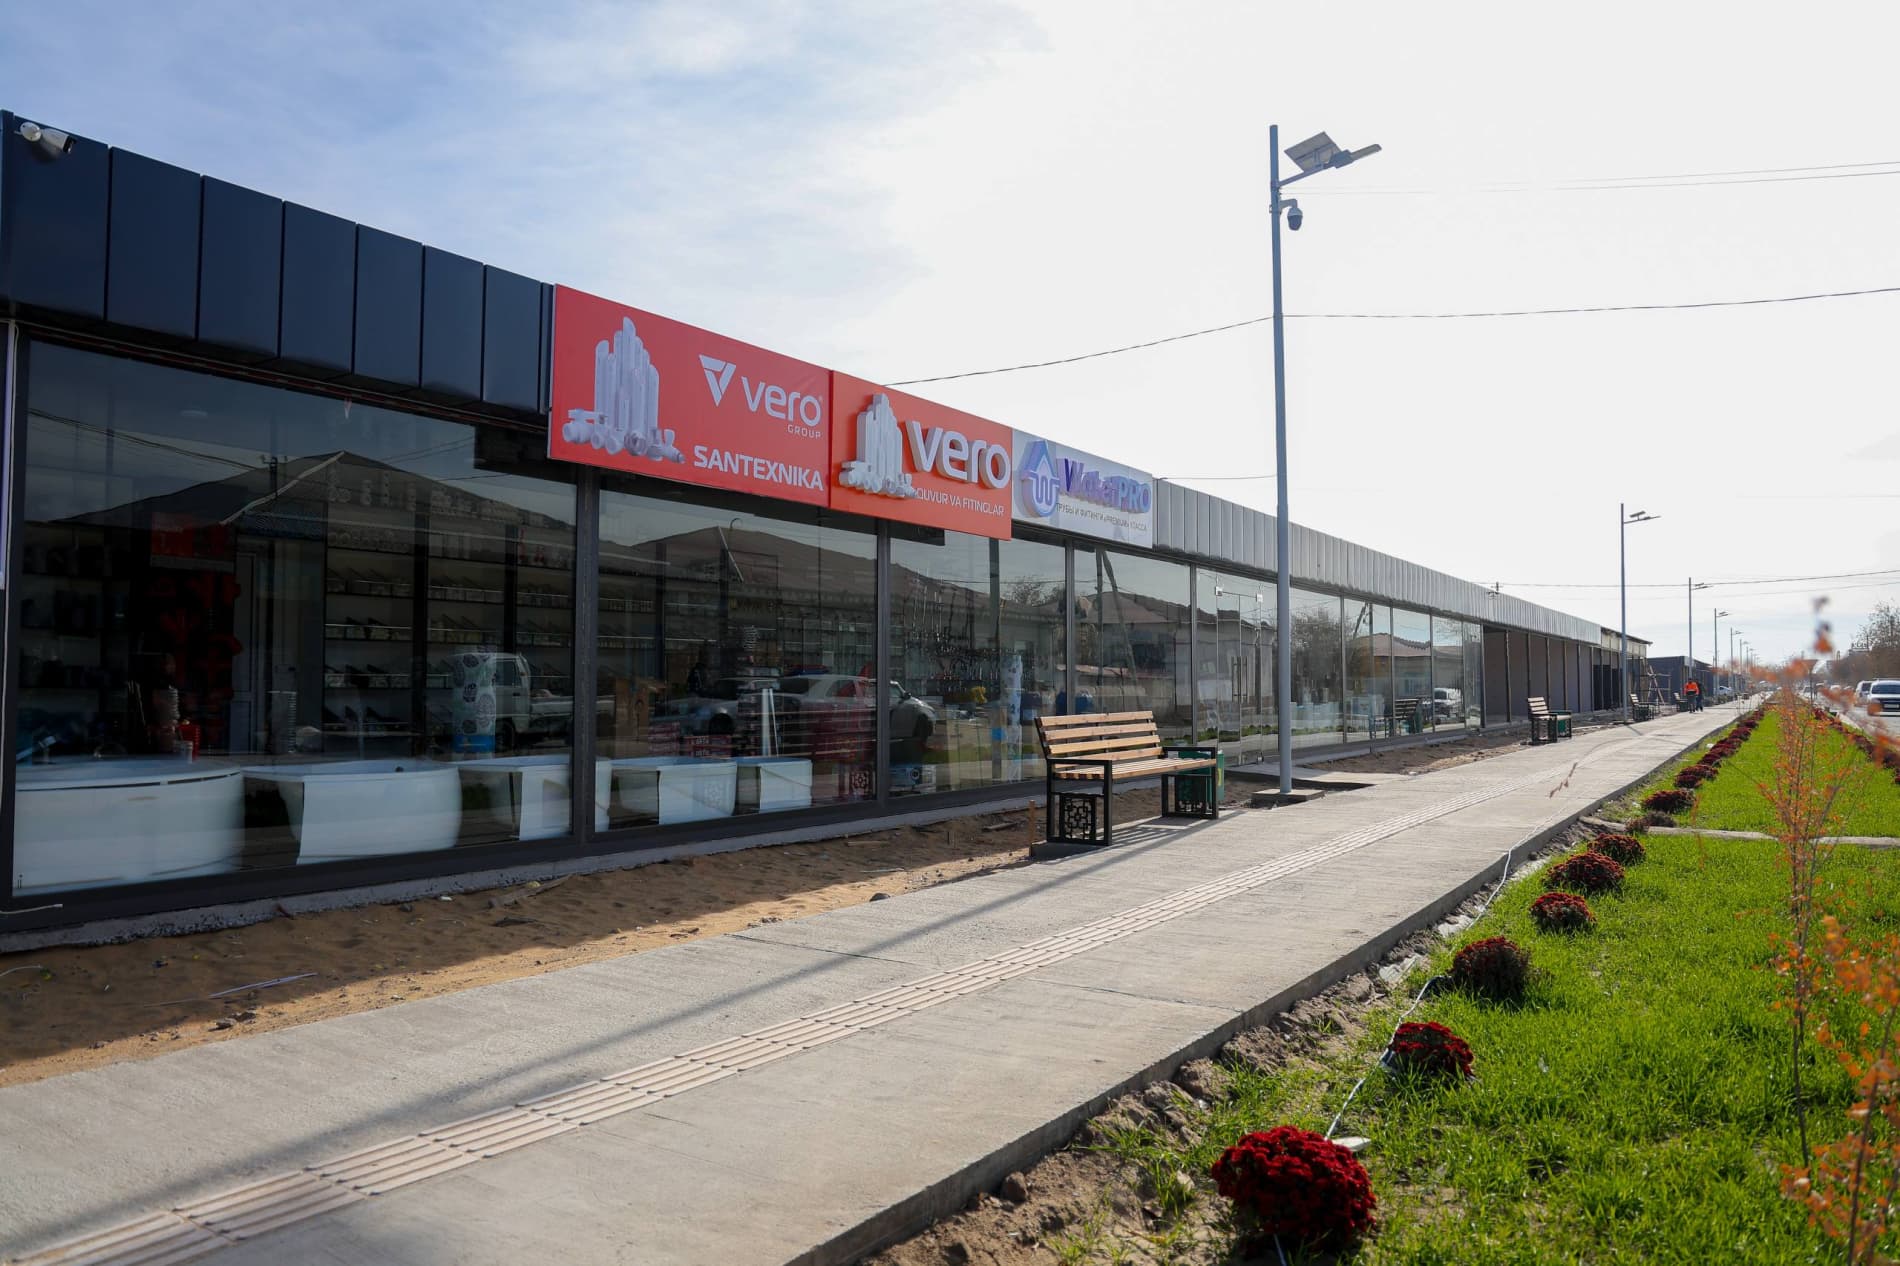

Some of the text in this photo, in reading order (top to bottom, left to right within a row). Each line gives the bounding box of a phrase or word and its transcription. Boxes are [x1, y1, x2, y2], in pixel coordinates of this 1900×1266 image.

[741, 376, 822, 427] vero
[787, 424, 821, 439] GROUP
[905, 419, 1011, 489] vero
[694, 445, 824, 491] SANTEXNIKA
[949, 494, 961, 508] VA
[962, 497, 1004, 517] FITINGLAR
